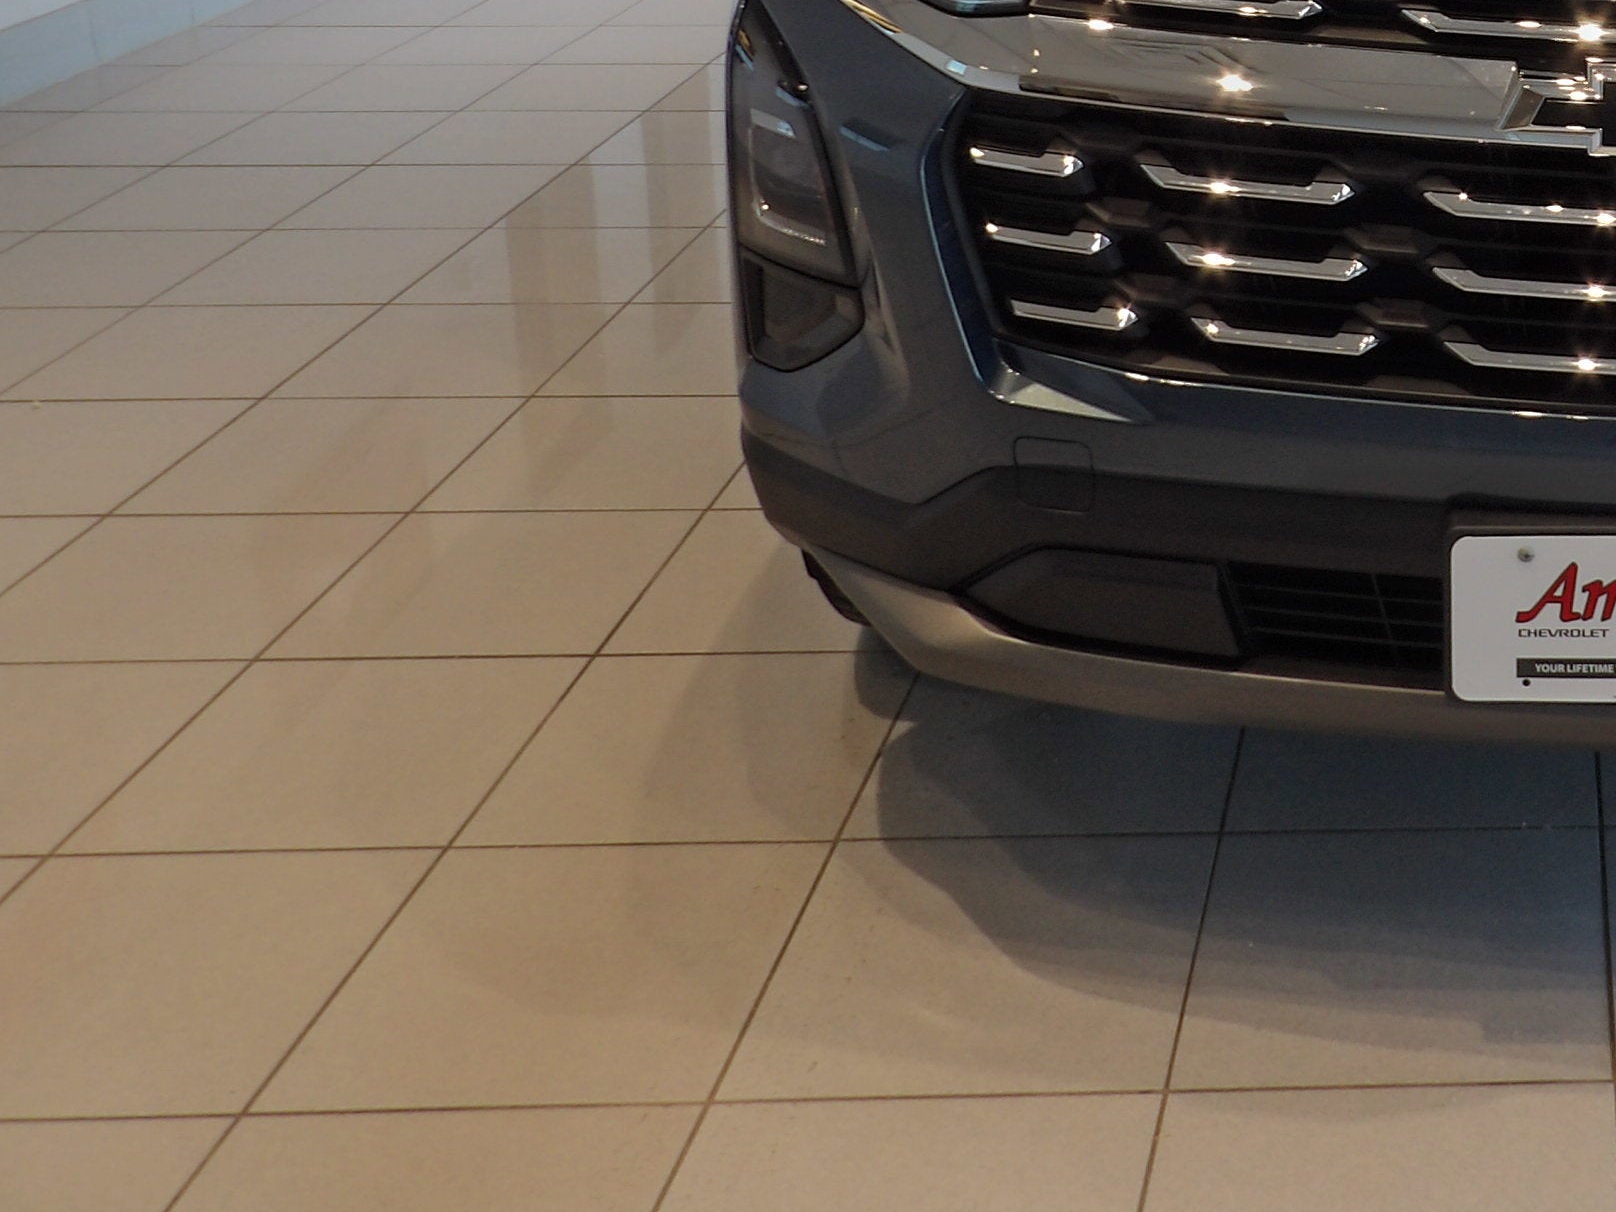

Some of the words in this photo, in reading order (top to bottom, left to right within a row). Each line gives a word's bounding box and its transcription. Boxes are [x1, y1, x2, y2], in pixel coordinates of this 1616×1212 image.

[1517, 628, 1610, 638] CHEVROLET
[1535, 663, 1565, 673] YOUR
[1566, 663, 1615, 673] LIFETIME
